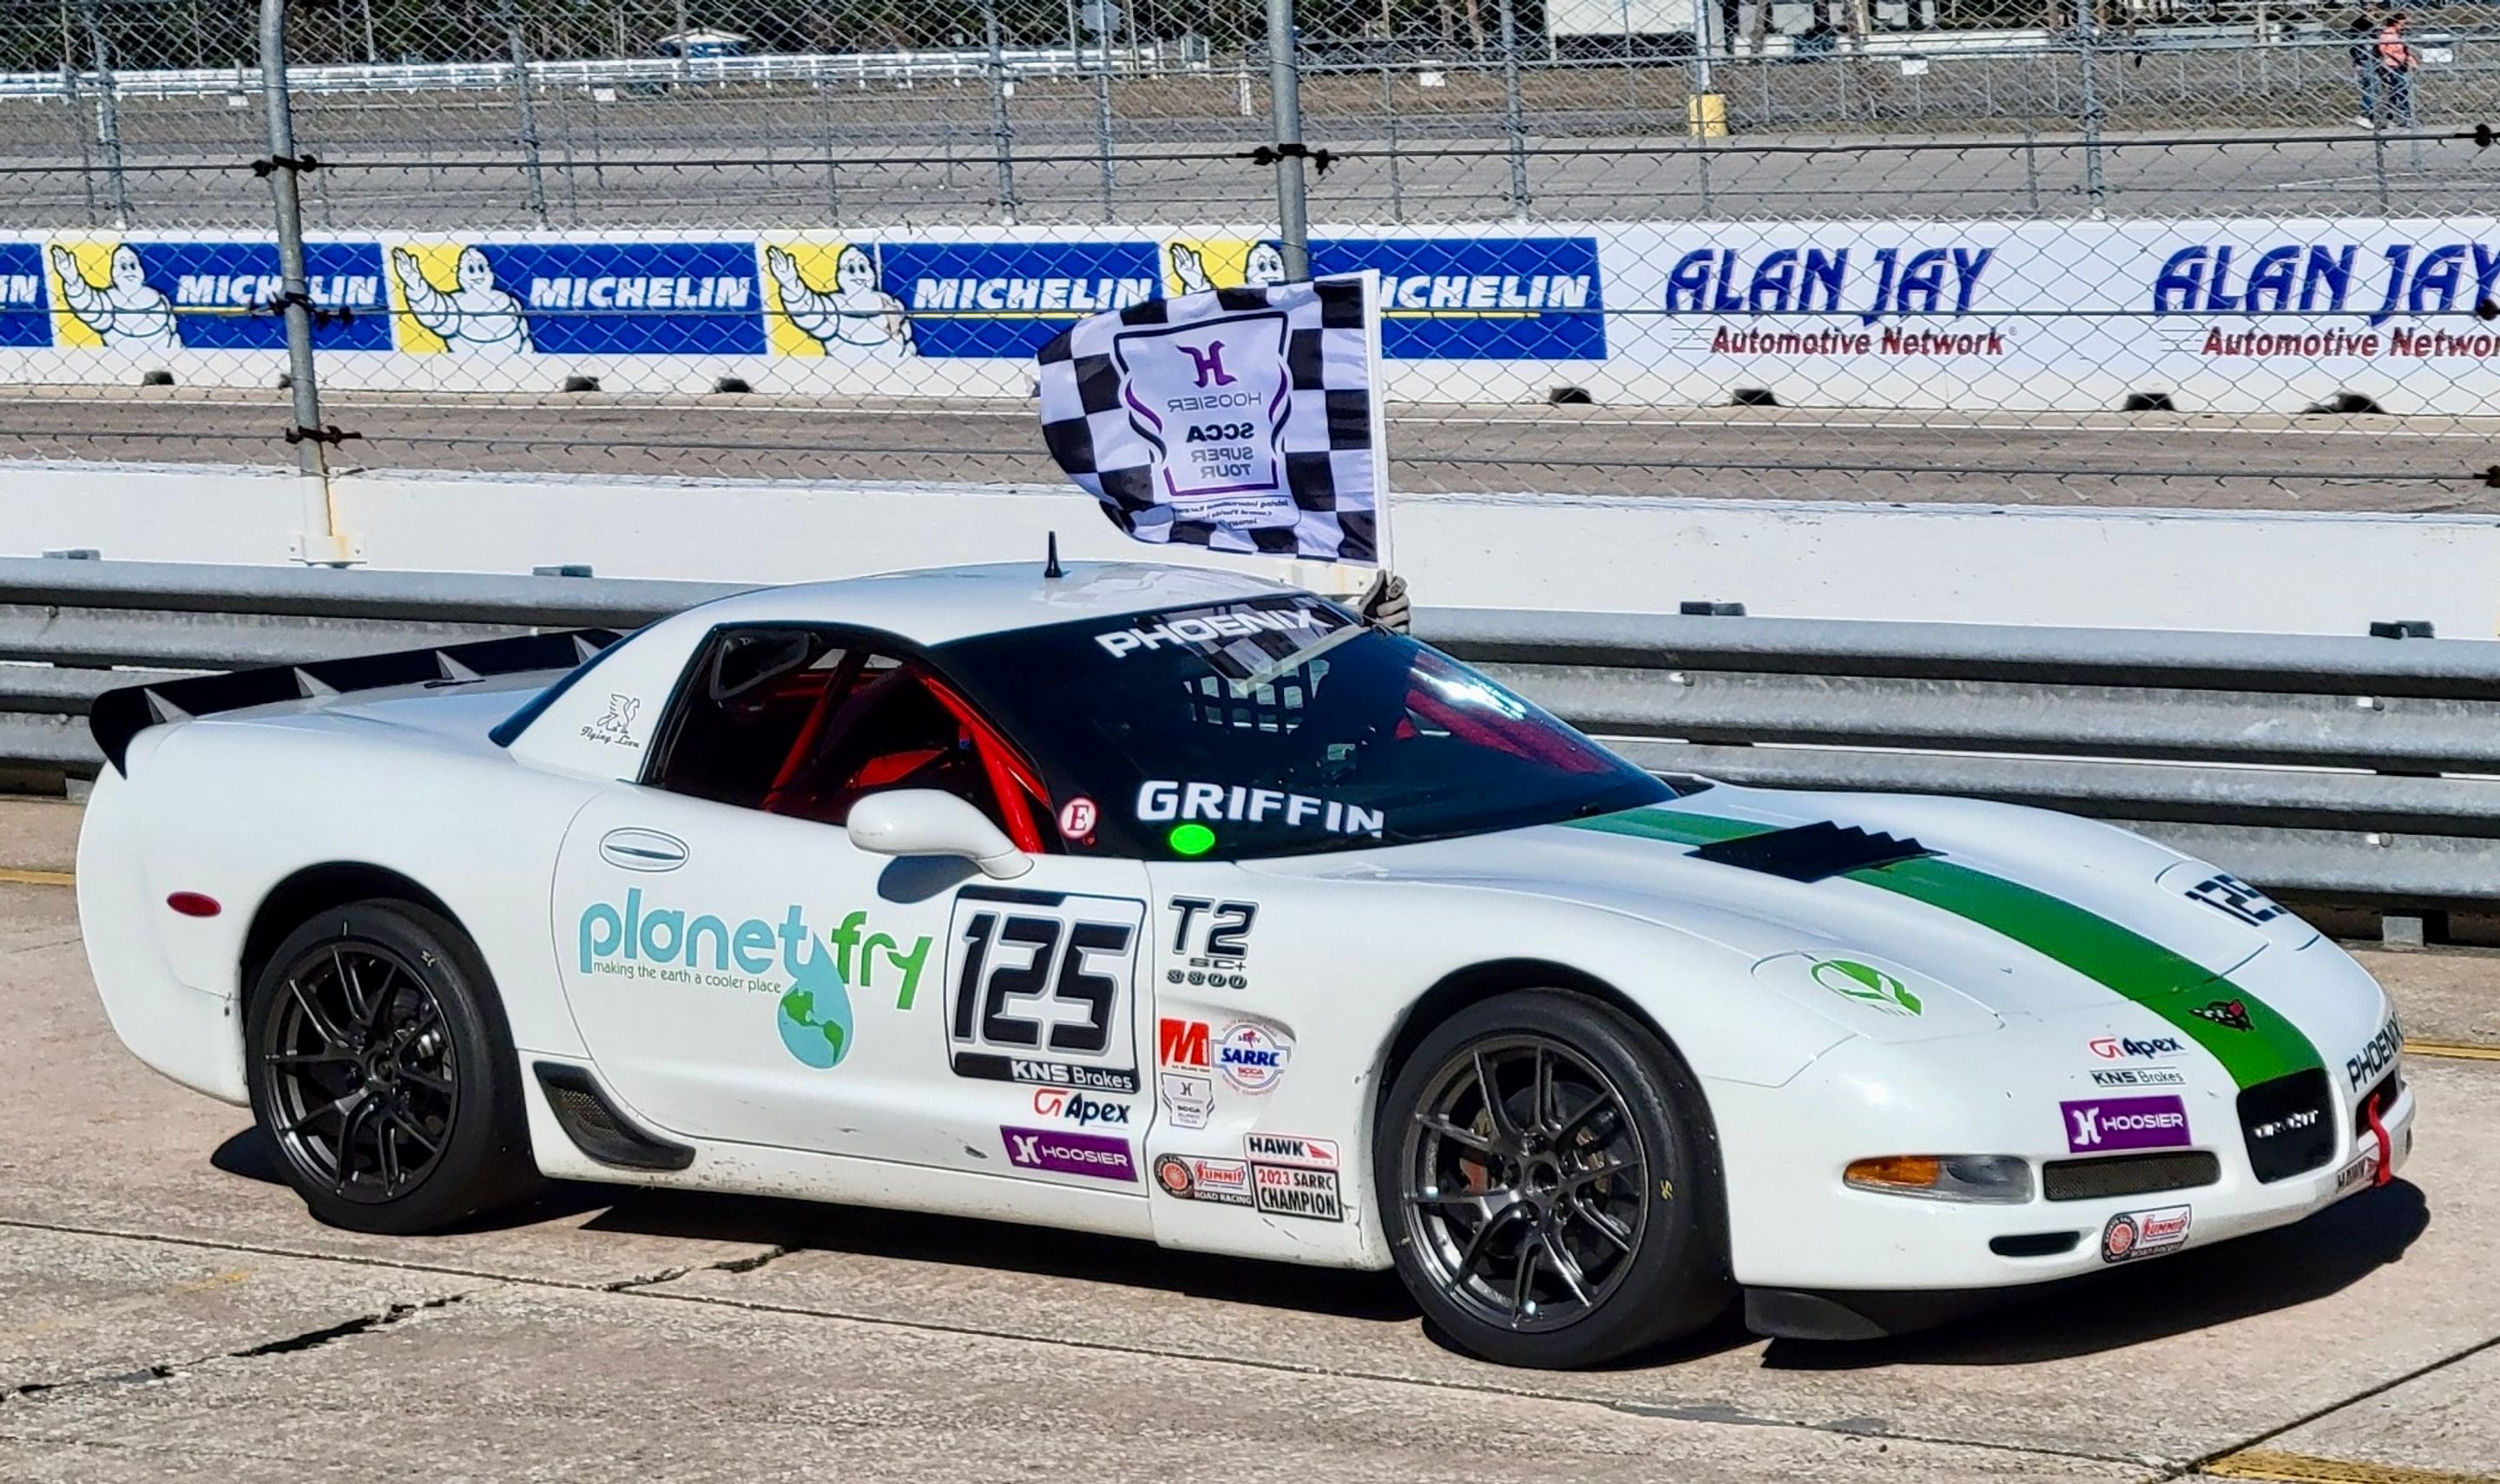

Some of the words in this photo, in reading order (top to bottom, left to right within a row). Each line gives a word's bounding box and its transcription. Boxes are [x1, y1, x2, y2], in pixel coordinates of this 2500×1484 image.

[176, 274, 378, 304] MICHLIN
[530, 276, 750, 308] MICHELIN
[913, 278, 1152, 310] MICHELIN
[1379, 275, 1591, 307] ICHELIN
[1666, 248, 1853, 317] ALAN
[1860, 248, 1996, 325] JAY
[2154, 245, 2359, 316] ALAN
[1711, 326, 1872, 355] Automotive
[1880, 326, 2006, 355] Network
[2201, 326, 2379, 357] Automotive
[1095, 608, 1334, 659] PHOENIX
[580, 726, 612, 745] Flying
[614, 734, 640, 748] Lion
[1067, 804, 1090, 832] E
[1136, 781, 1385, 839] GRIFFIN
[2184, 874, 2288, 927] 125
[1168, 894, 1260, 960] T2
[579, 887, 810, 979] planet
[831, 910, 934, 1010] fry
[593, 959, 635, 979] making
[637, 965, 657, 978] the
[660, 969, 691, 984] earth
[694, 975, 702, 985] a
[705, 974, 745, 989] cooler
[747, 976, 781, 994] place
[952, 909, 1136, 1057] 125
[1220, 1047, 1281, 1067] SARRC
[2122, 1037, 2186, 1060] Apex
[2346, 1011, 2405, 1093] PHOENIX
[1010, 1059, 1070, 1082] KNS
[1073, 1067, 1134, 1089] Brakes
[2091, 1071, 2138, 1085] KNS
[2138, 1070, 2185, 1084] Brakes
[1064, 1093, 1131, 1126] Apex
[2102, 1113, 2185, 1132] HOOSIER
[1042, 1145, 1128, 1167] HOOSIER
[1248, 1136, 1306, 1158] HAWK
[1258, 1168, 1291, 1185] 2023
[1294, 1172, 1333, 1192] SARRC
[1220, 1192, 1253, 1205] RACING
[1260, 1186, 1337, 1216] CHAMPION
